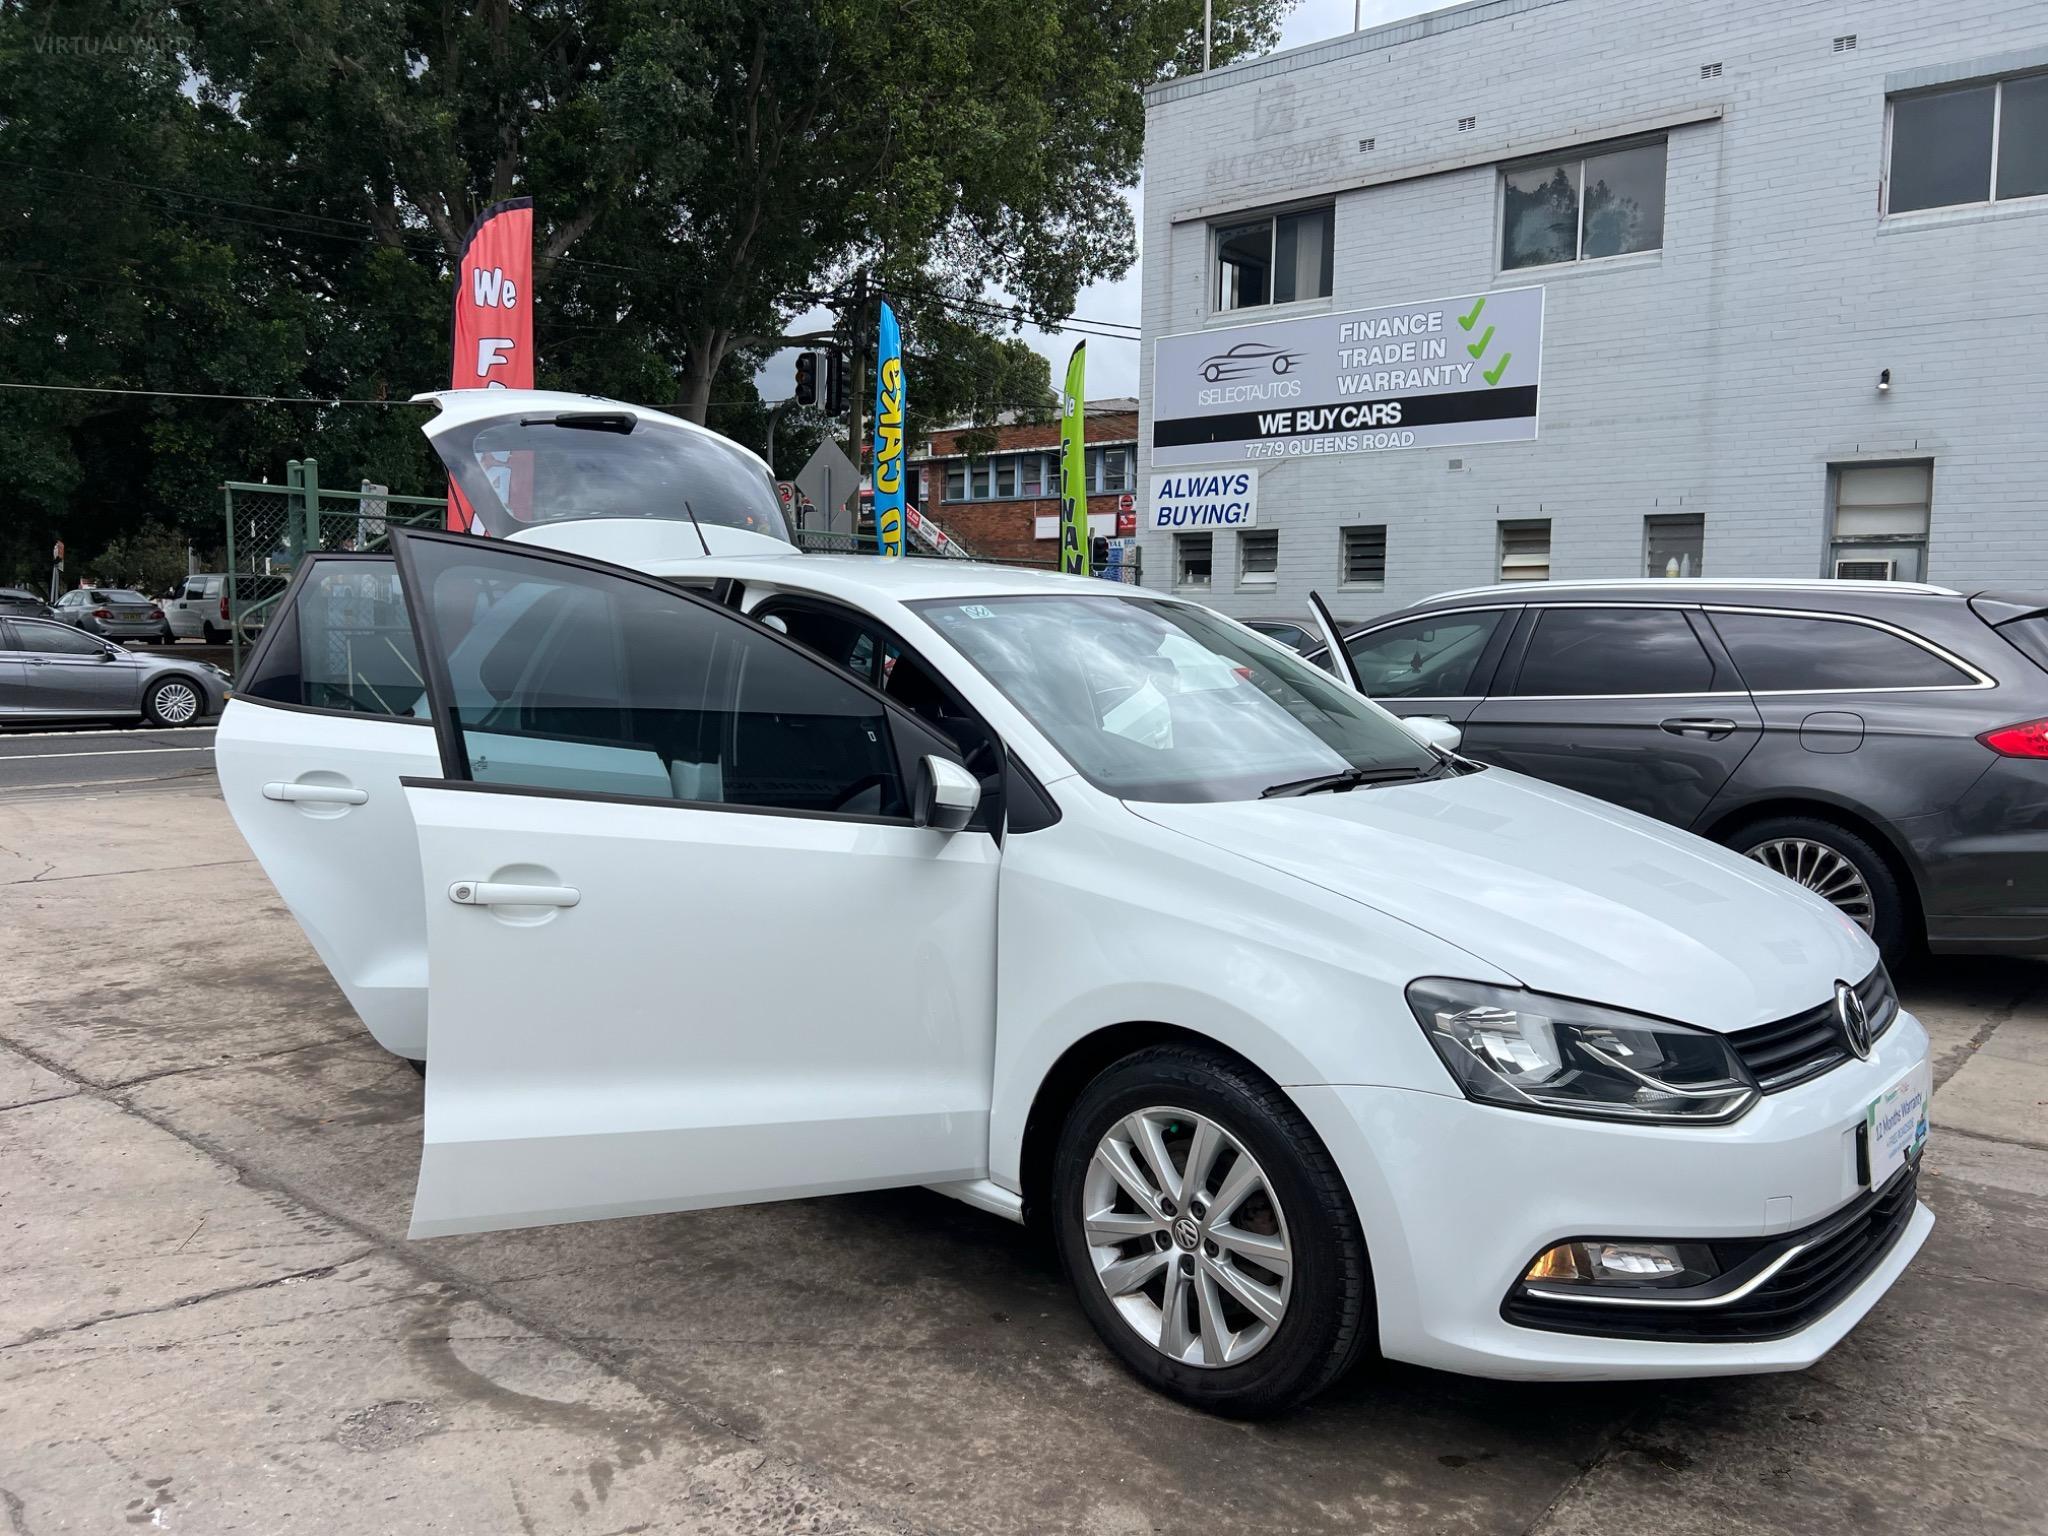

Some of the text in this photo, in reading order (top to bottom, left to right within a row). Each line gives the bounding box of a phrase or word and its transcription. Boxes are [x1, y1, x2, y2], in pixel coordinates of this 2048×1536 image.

[473, 267, 517, 309] We
[1338, 311, 1443, 343] FINANCE
[1338, 337, 1447, 369] TRADE IN
[1337, 361, 1475, 395] WARRANTY
[1258, 402, 1402, 434] WE BUY CARS
[1245, 431, 1415, 458] 77-79 QUEENS ROAD
[1158, 474, 1249, 499] ALWAYS
[1157, 503, 1250, 526] BUYING!
